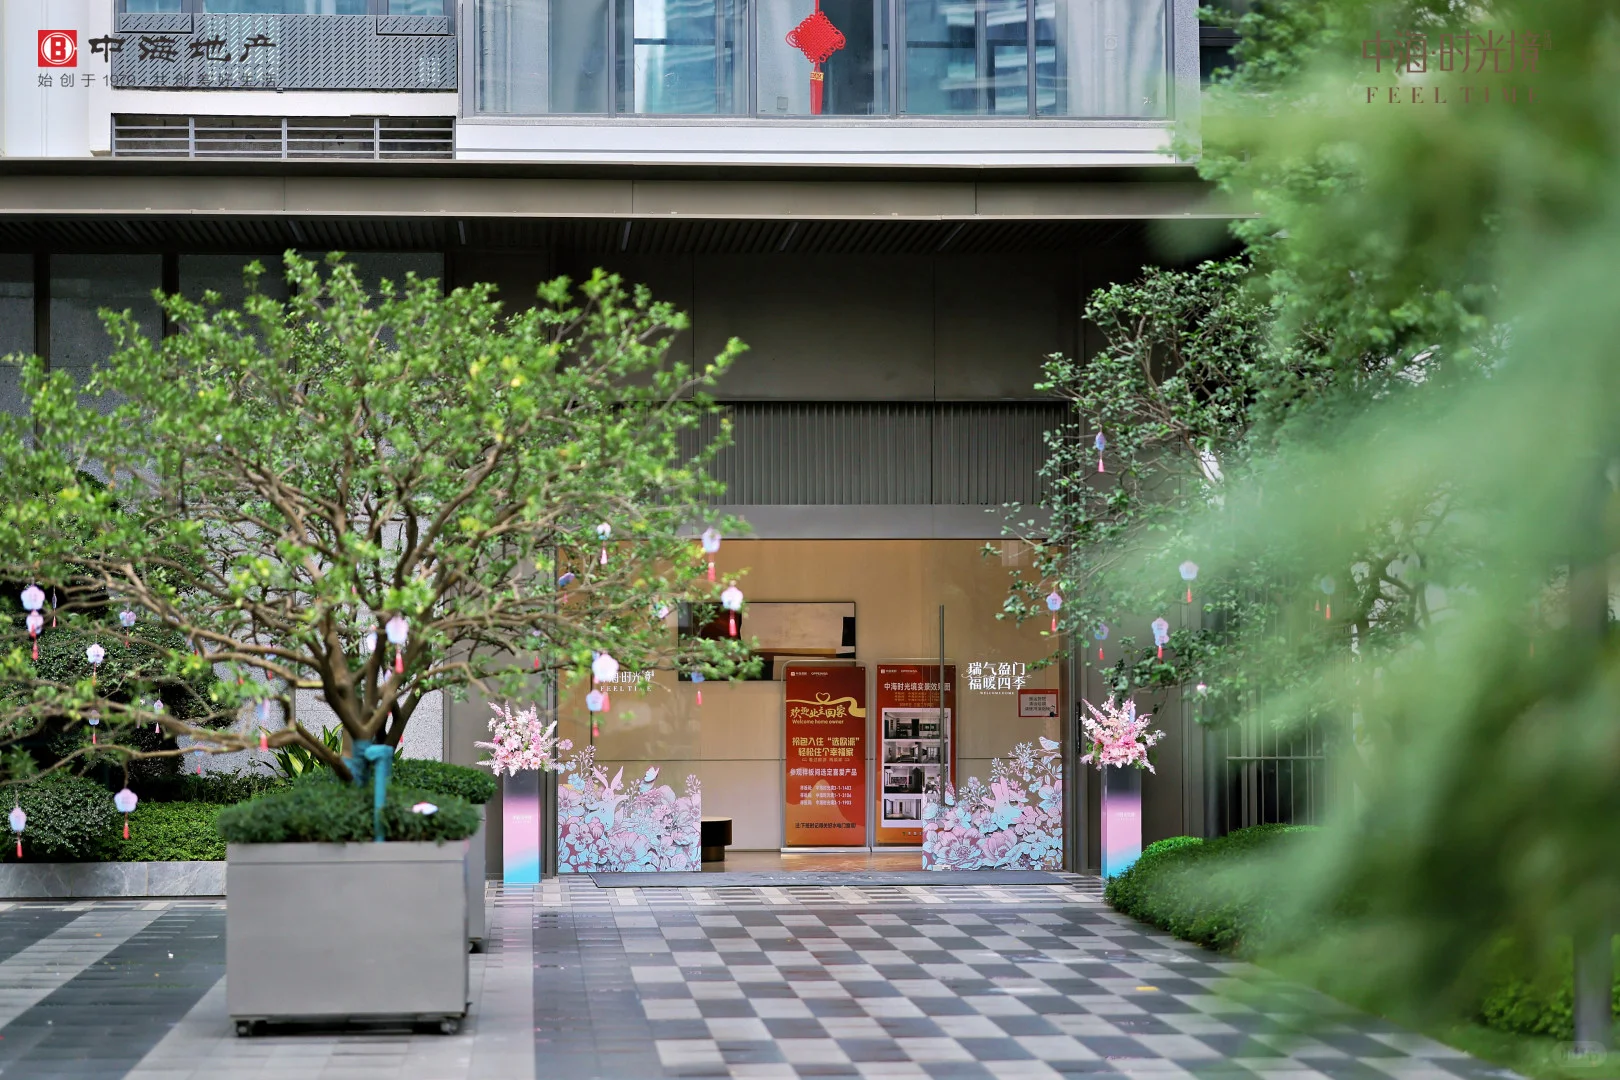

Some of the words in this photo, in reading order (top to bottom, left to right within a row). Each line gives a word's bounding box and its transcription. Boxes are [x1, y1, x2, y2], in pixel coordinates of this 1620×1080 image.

[967, 661, 1026, 676] 瑞气盈门
[967, 676, 1026, 690] 福暖四季
[790, 704, 847, 719] 欢迎业主回家
[792, 737, 824, 747] 拎包入住
[798, 747, 854, 757] 轻松住个幸福家
